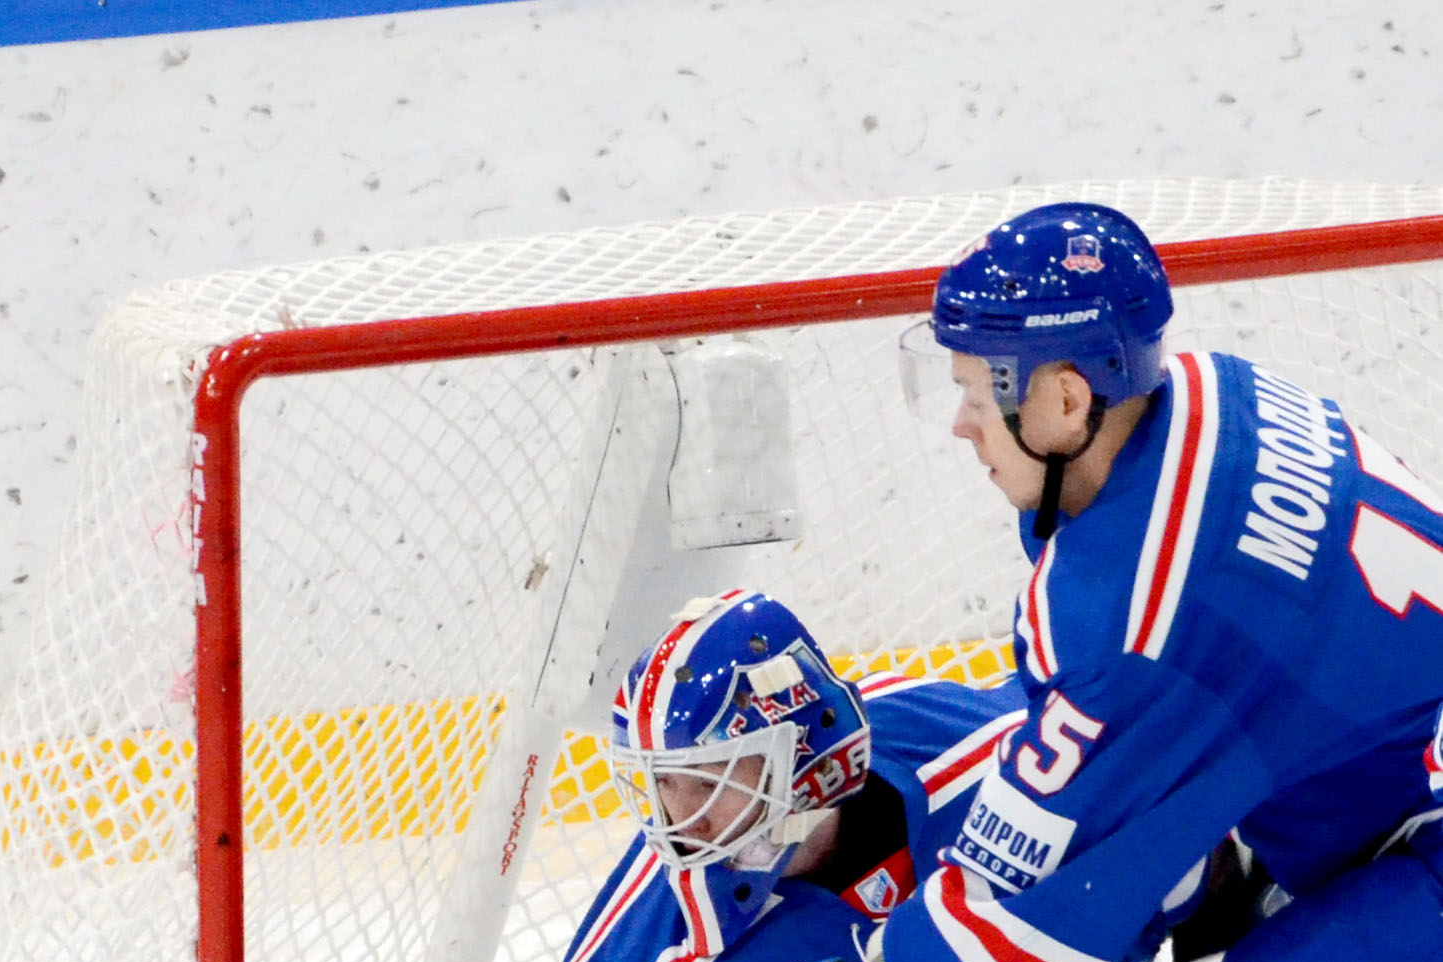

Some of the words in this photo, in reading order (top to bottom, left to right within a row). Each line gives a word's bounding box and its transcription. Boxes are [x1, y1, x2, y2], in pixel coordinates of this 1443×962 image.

[1025, 309, 1099, 327] BAUER
[999, 688, 1106, 798] 5
[792, 741, 872, 812] ЕВА
[956, 832, 1032, 888] СПОРТ
[970, 804, 1052, 870] ЗПРОМ
